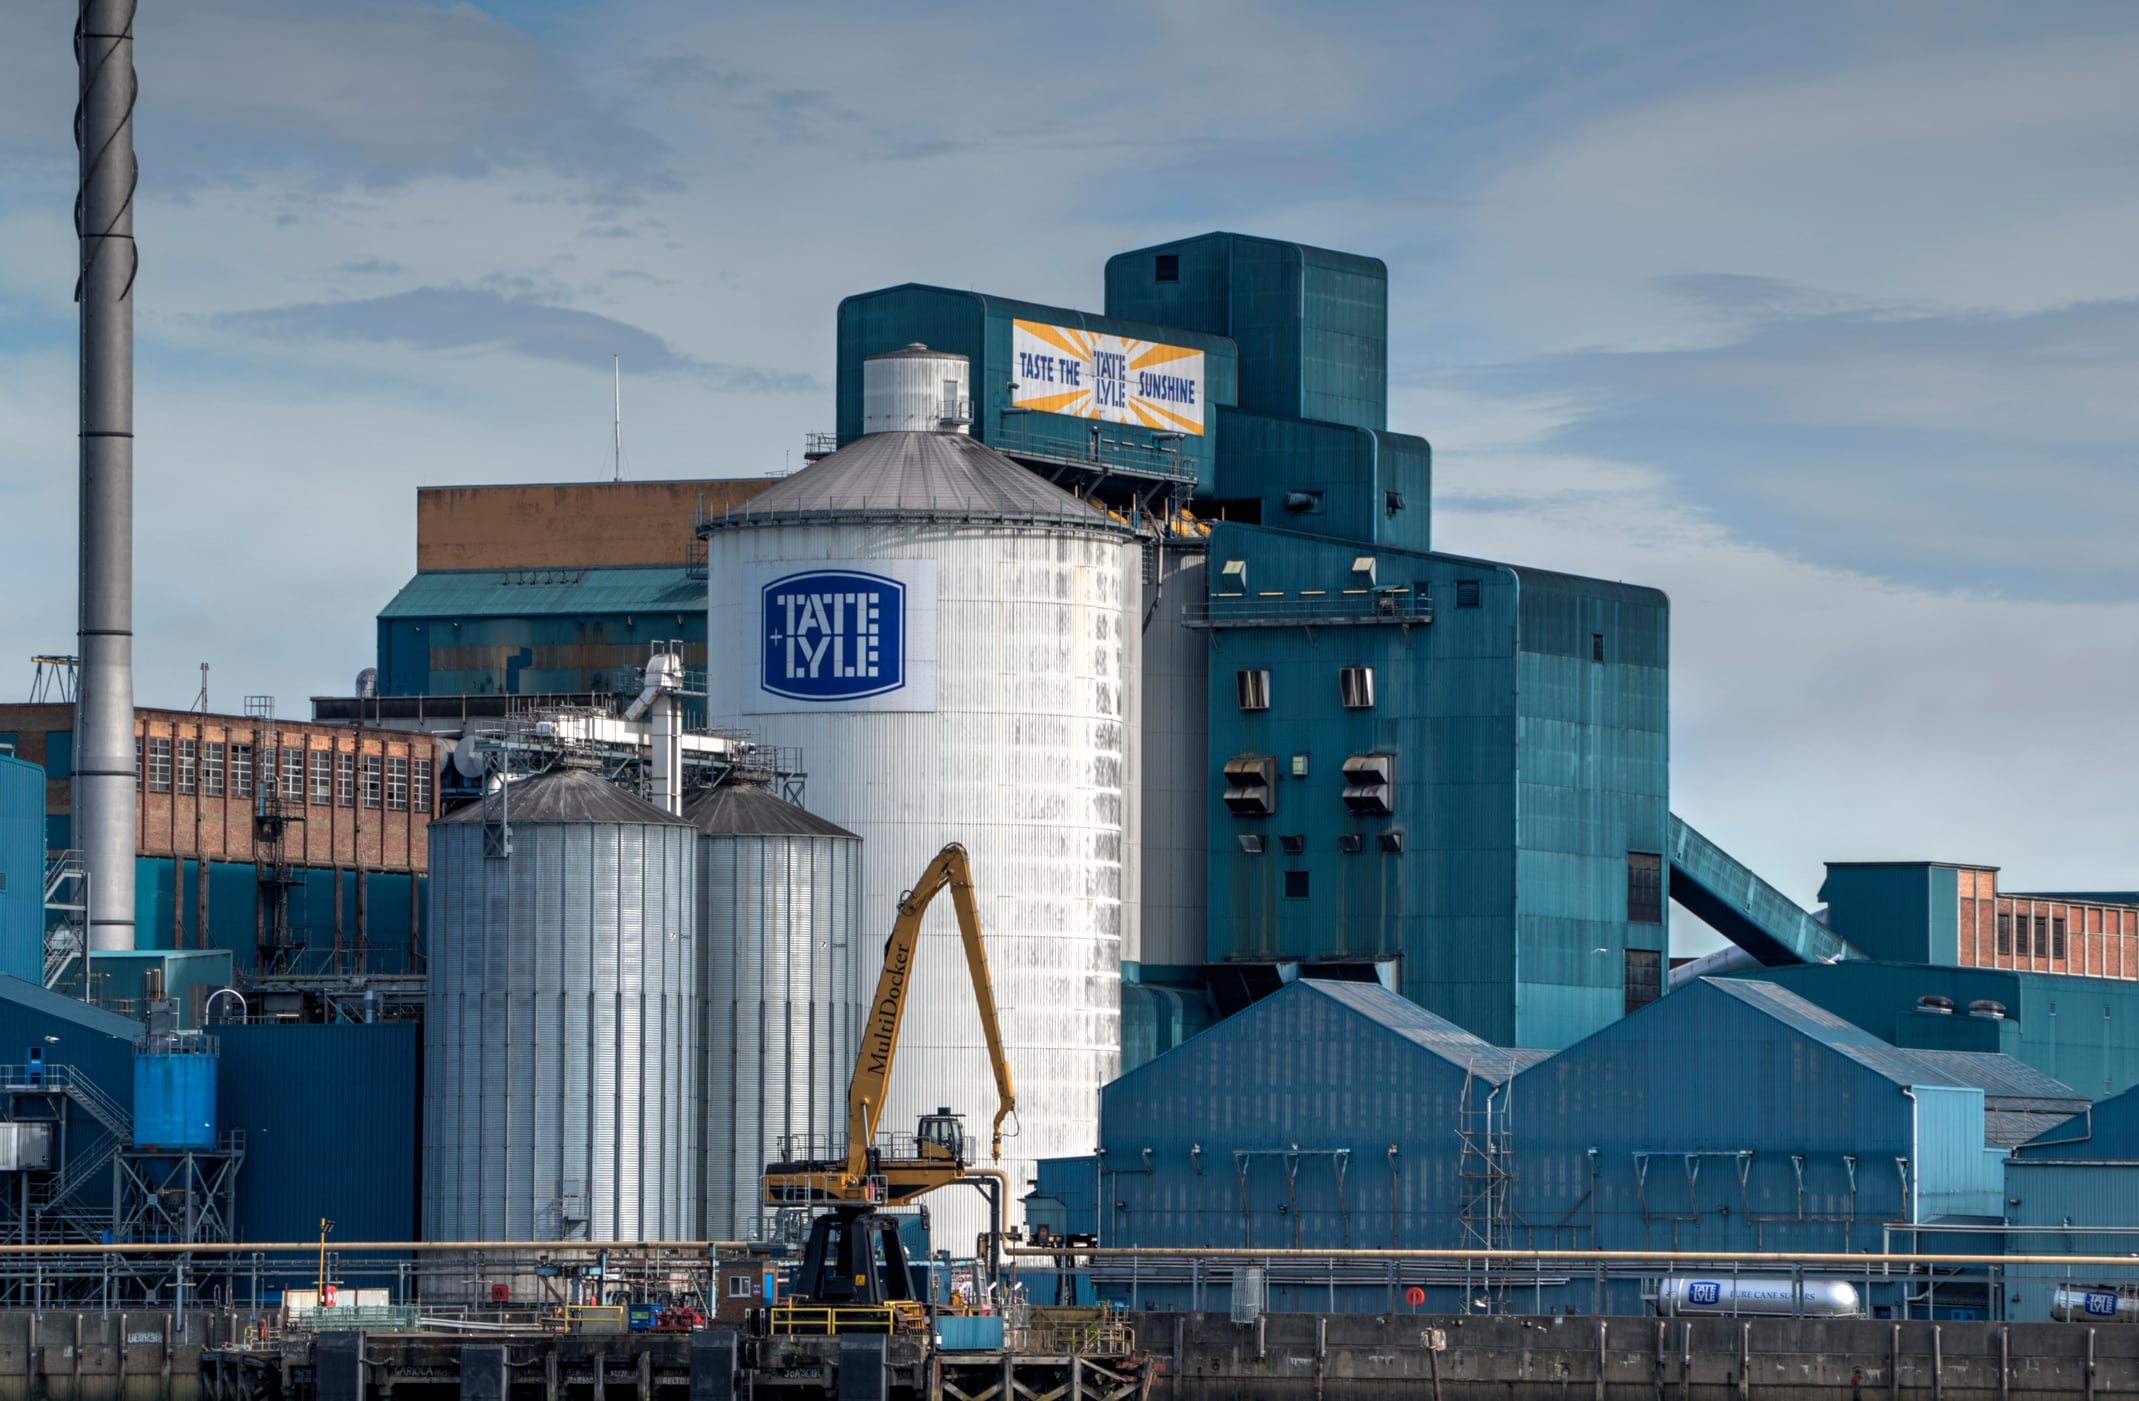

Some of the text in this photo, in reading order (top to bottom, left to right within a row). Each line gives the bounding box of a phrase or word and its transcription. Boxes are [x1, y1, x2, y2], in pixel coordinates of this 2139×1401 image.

[1020, 352, 1080, 386] TASTE THE
[1093, 350, 1125, 381] TATE
[1096, 378, 1125, 408] LYLE
[1139, 371, 1195, 404] SUNSHINE
[777, 593, 879, 635] TATE
[786, 636, 879, 678] LYLE
[867, 944, 910, 1076] MultiDocker
[1693, 1284, 1717, 1293] TATE
[1693, 1292, 1716, 1302] LYLE
[1754, 1291, 1778, 1300] CANE
[1779, 1292, 1816, 1301] SURS
[2088, 1294, 2114, 1303] TATE
[2089, 1303, 2113, 1314] LYLE
